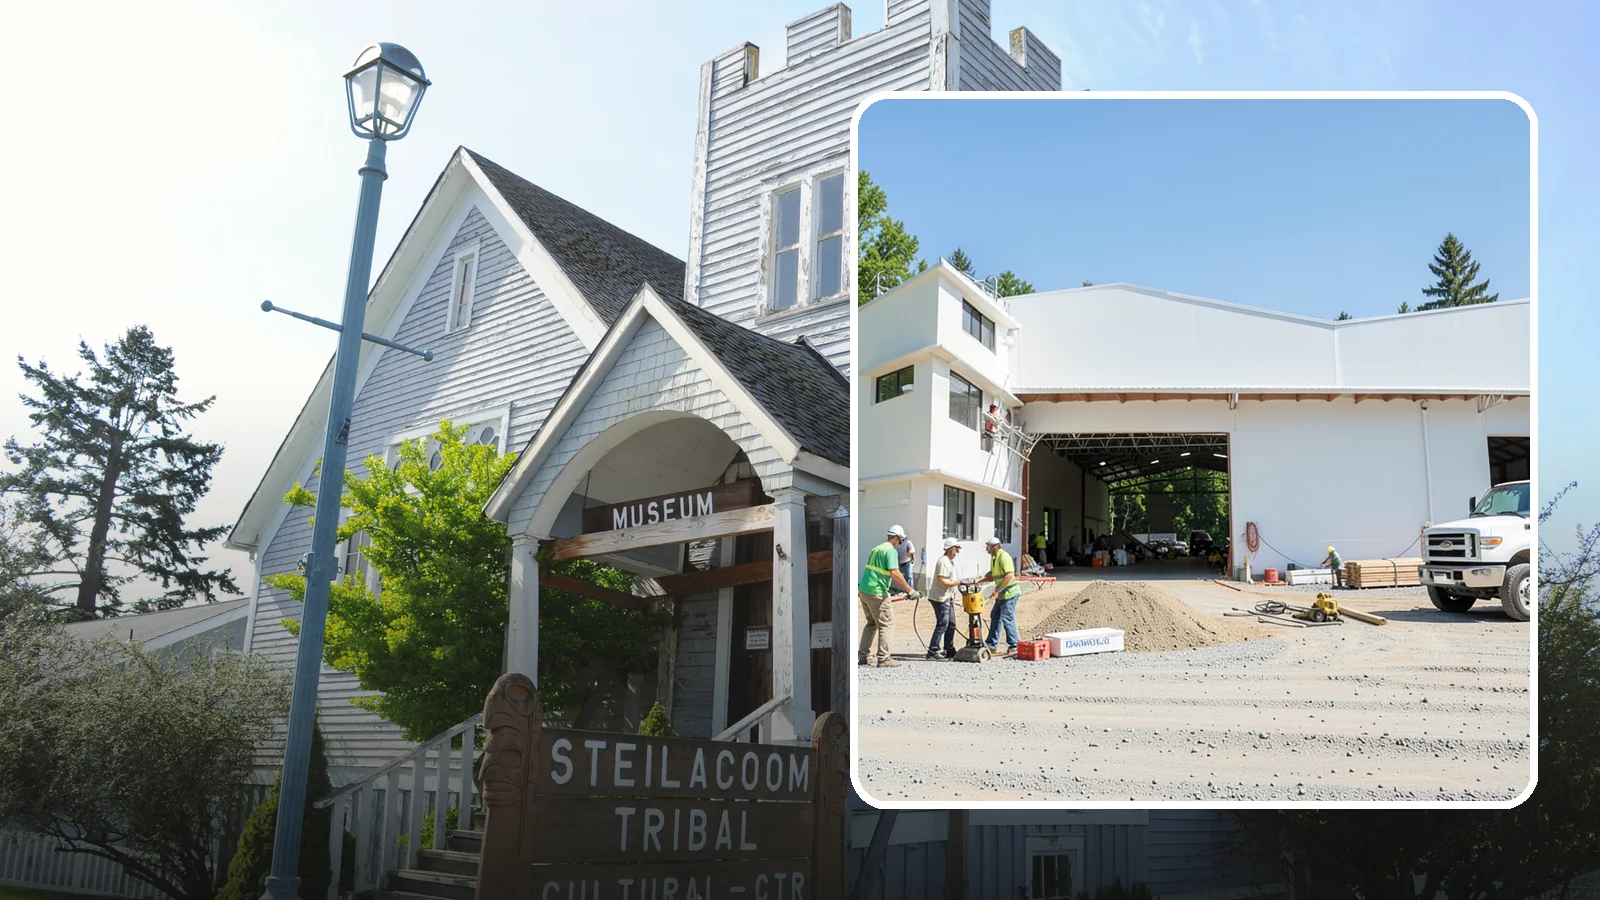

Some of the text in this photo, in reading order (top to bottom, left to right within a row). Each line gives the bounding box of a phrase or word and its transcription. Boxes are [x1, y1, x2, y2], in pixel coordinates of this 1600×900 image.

[613, 491, 713, 531] MUSEUM
[550, 738, 810, 793] STEILACOOM
[615, 806, 758, 852] TRIBAL
